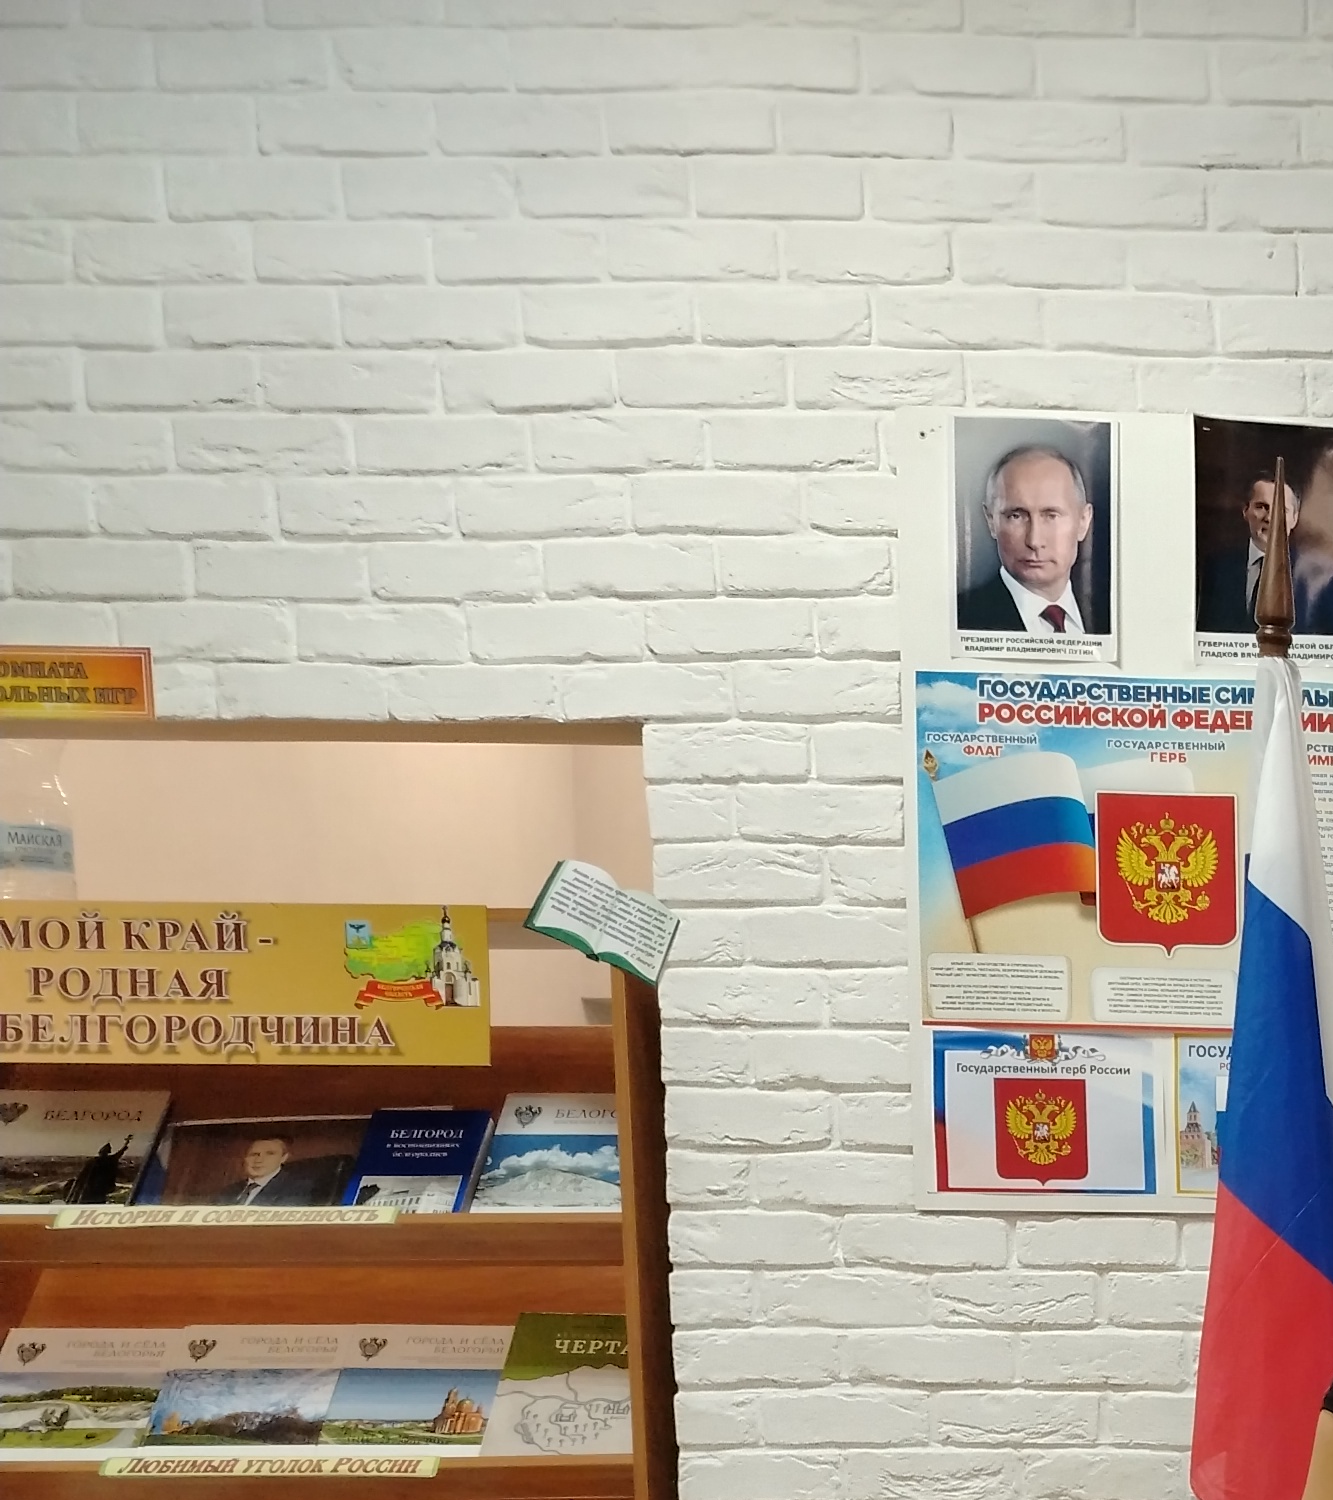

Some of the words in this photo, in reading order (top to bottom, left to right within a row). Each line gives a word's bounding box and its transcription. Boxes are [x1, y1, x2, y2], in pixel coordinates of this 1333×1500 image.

[1006, 637, 1054, 645] РОССИЙСКОЙ
[1056, 639, 1102, 647] ФЕДЕРАЦИИ
[1197, 640, 1249, 648] ГУБЕРНАТОР
[1006, 646, 1066, 654] ВЛАДИМИРОВИЧ
[94, 686, 137, 704] ИГР
[978, 680, 1211, 705] ГОСУДАРСТВЕННЫЕ
[978, 700, 1166, 729] РОССИЙСКОЙ
[926, 732, 1037, 745] ГОСУДАРСТВЕННЫЙ
[1107, 738, 1226, 751] ГОСУДАРСТВЕННЫЙ
[963, 745, 1003, 759] ФЛАГ
[1150, 752, 1187, 763] ГЕРБ
[0, 909, 108, 952] МОЙ
[122, 911, 250, 953] КРАЙ
[27, 966, 230, 1006] РОДНАЯ
[0, 1013, 395, 1052] БЕЛГОРОДЧИНА
[956, 1062, 1058, 1076] Государственный
[1060, 1062, 1087, 1076] герб
[1089, 1065, 1131, 1076] России
[43, 1109, 144, 1123] БЕЛГОРОД
[390, 1128, 465, 1140] БЕЛГОРОД
